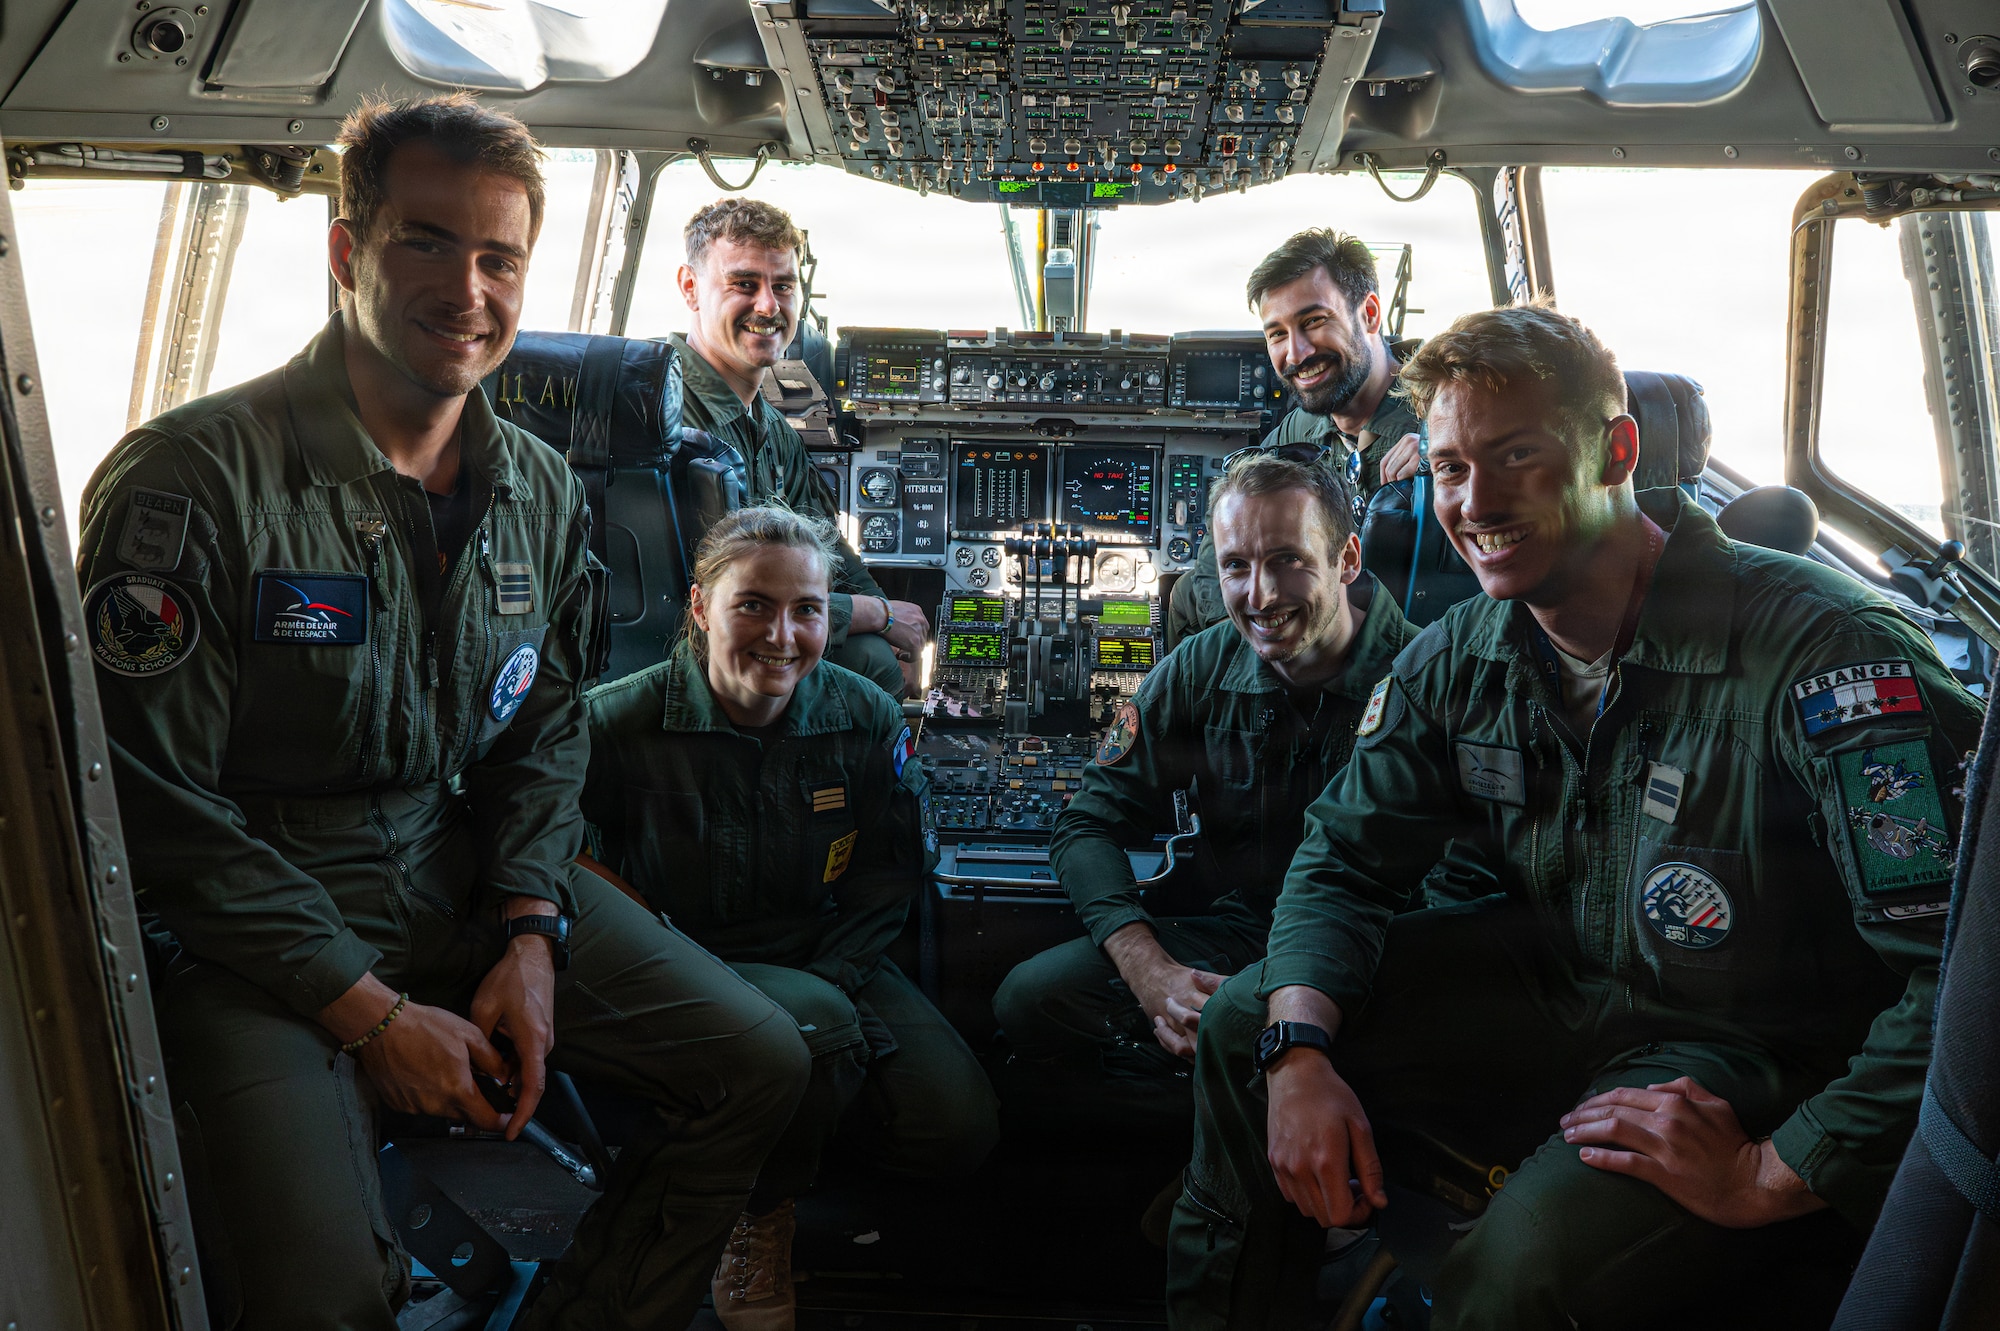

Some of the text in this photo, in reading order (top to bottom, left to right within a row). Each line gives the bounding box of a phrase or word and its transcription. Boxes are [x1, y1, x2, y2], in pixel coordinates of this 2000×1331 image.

[126, 575, 166, 590] GRADUATE
[274, 619, 305, 630] ARMÉE
[294, 630, 328, 638] L'ESPACE
[95, 642, 178, 672] WEAPONS SCHOOL
[1800, 663, 1902, 696] FRANCE
[1665, 929, 1687, 941] 250
